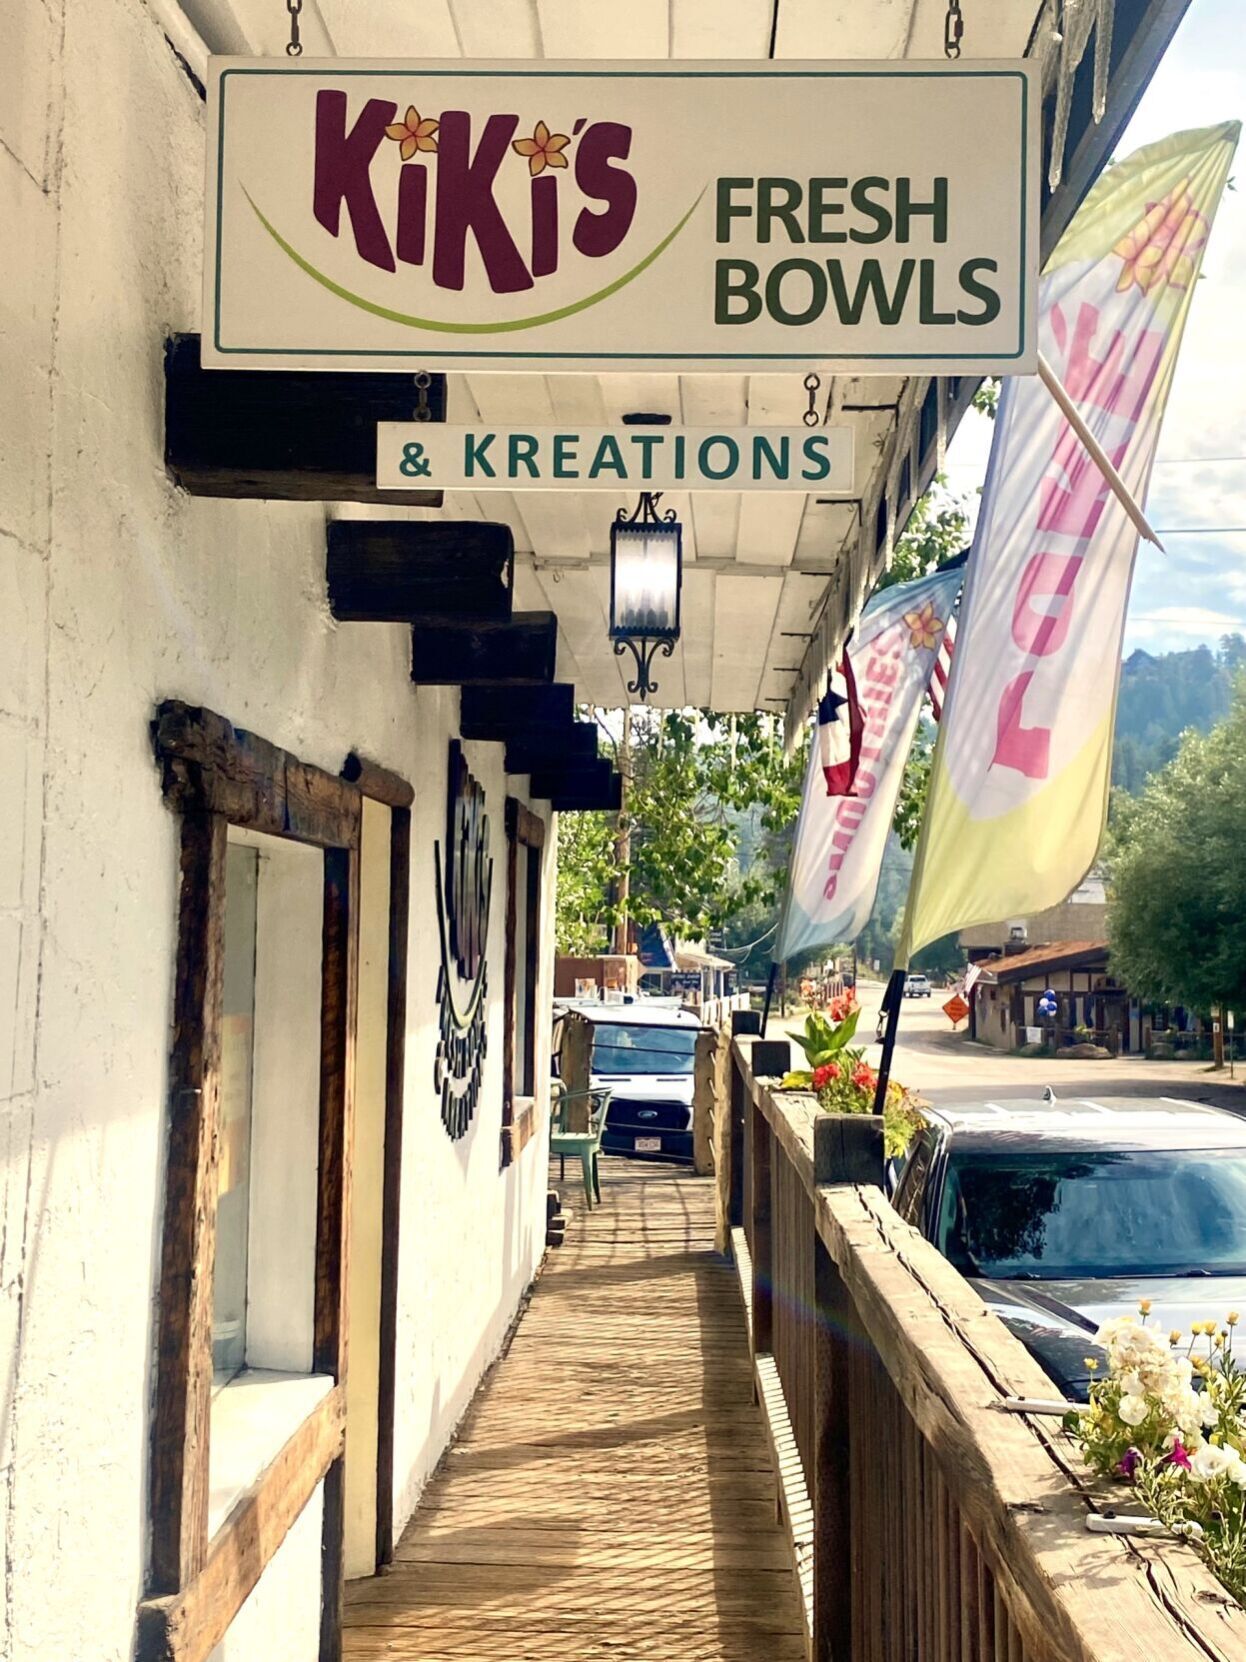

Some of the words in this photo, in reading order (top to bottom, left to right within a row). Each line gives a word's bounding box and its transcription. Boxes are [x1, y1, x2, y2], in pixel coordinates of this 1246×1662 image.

[717, 176, 948, 244] FRESH
[715, 258, 1000, 326] BOWLS
[400, 441, 432, 477] &
[465, 432, 832, 481] KREATIONS
